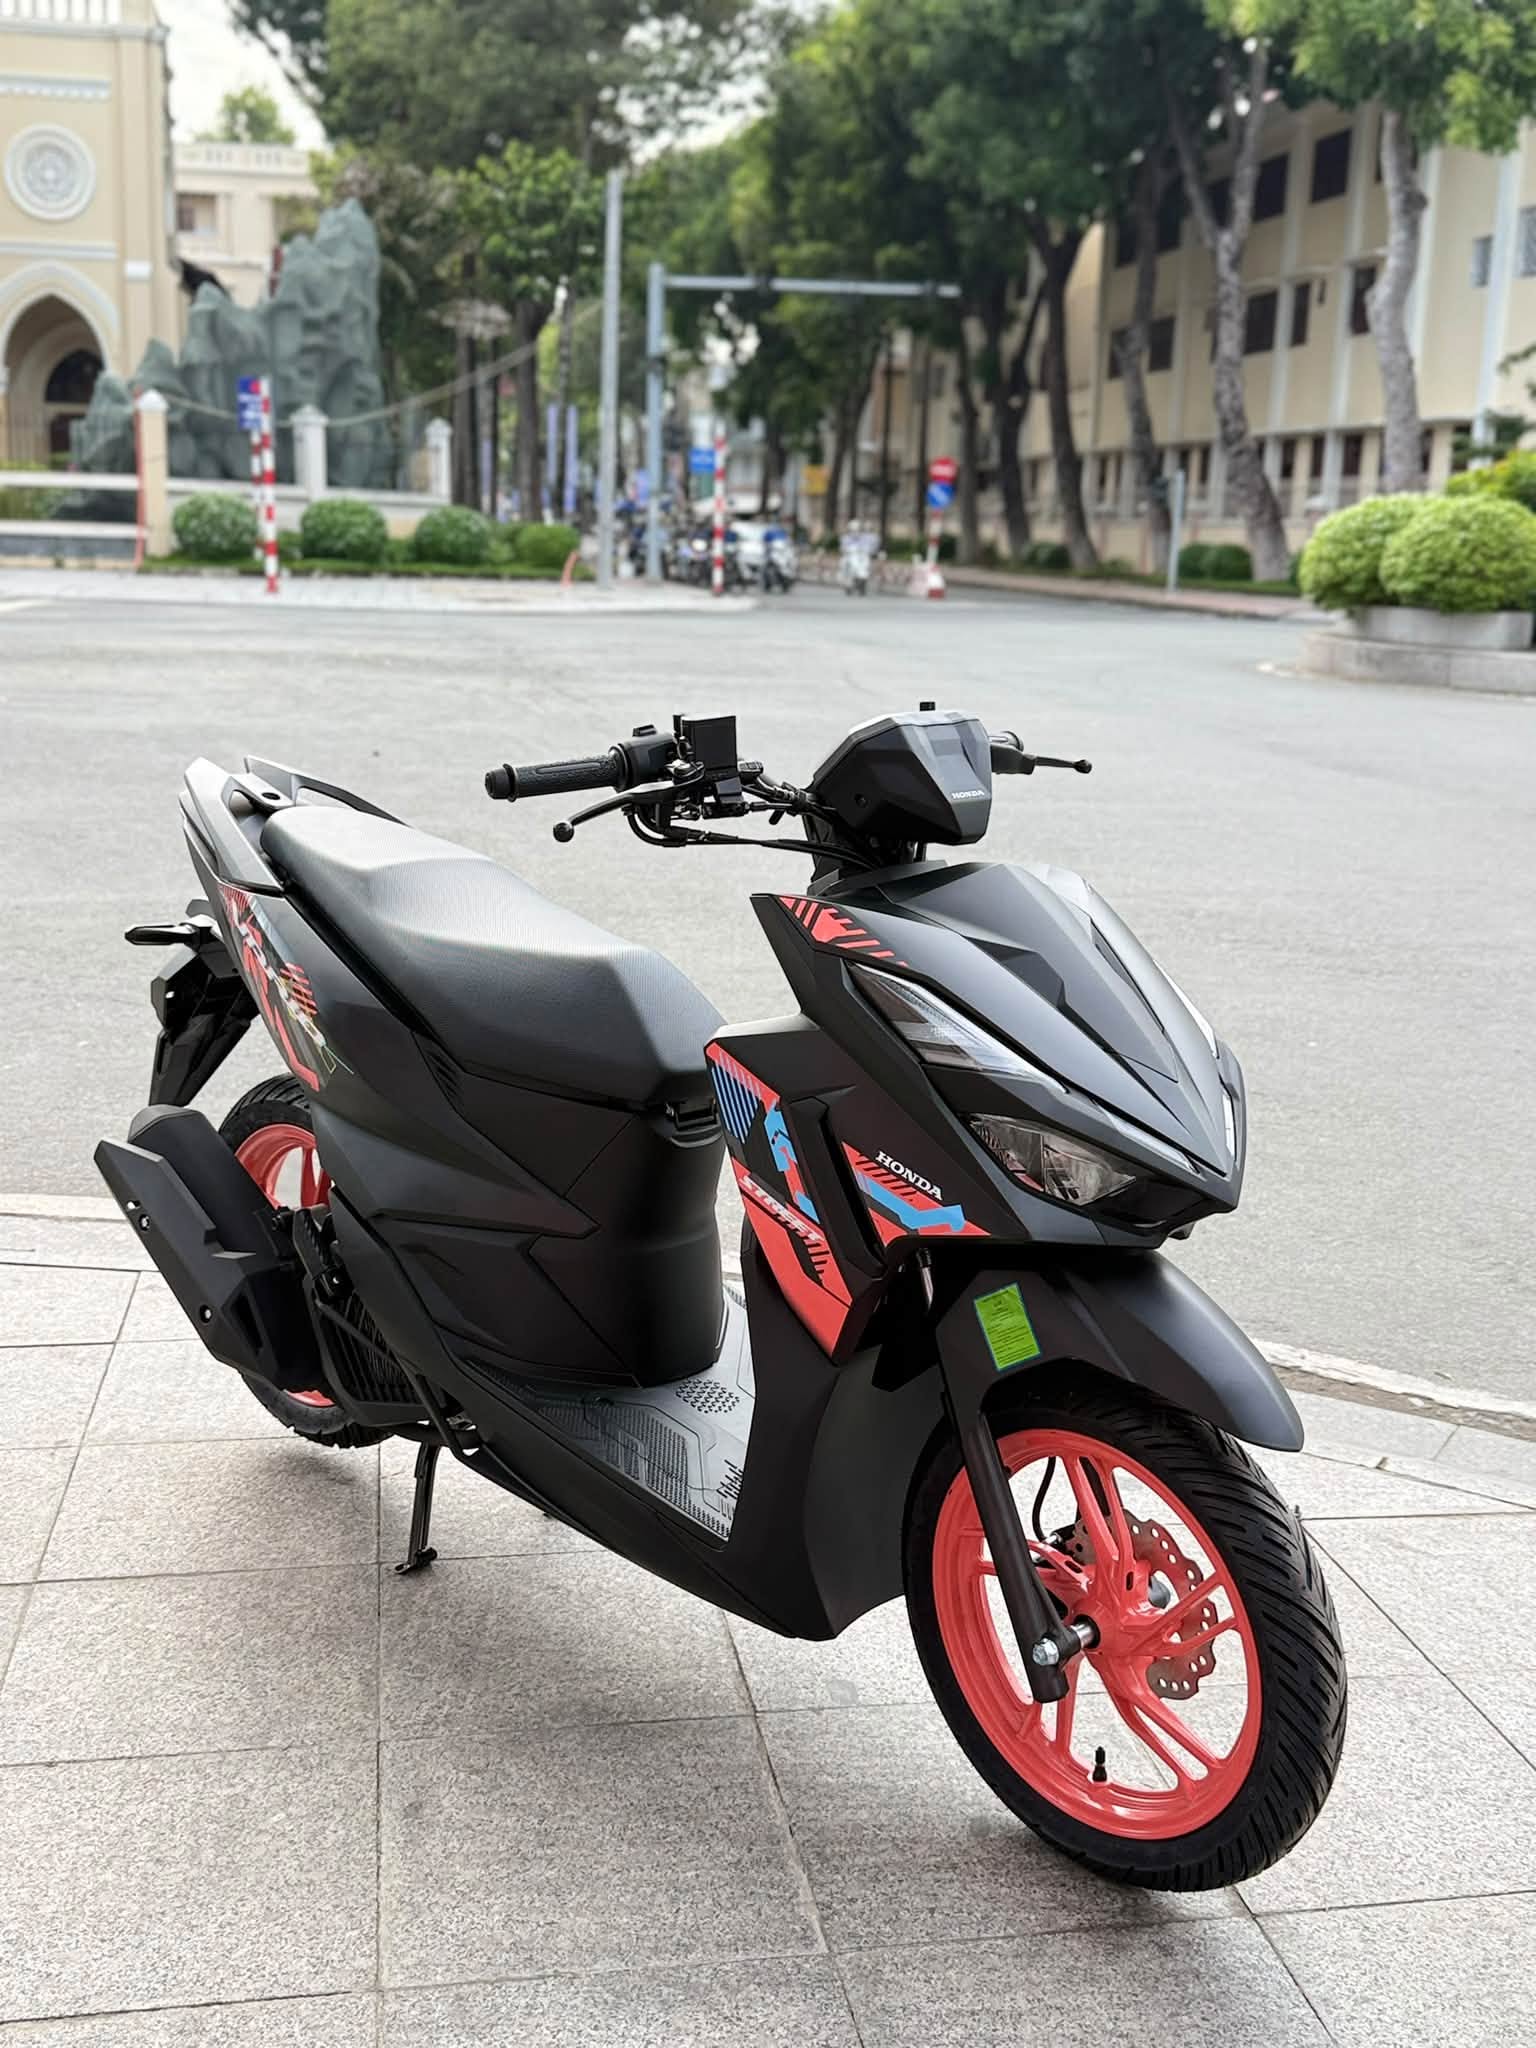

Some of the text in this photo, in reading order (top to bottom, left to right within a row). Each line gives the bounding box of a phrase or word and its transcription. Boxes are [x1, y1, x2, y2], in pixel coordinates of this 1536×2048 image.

[951, 790, 985, 799] HONDA
[875, 1150, 943, 1201] HONDA
[740, 1175, 825, 1241] STREET
